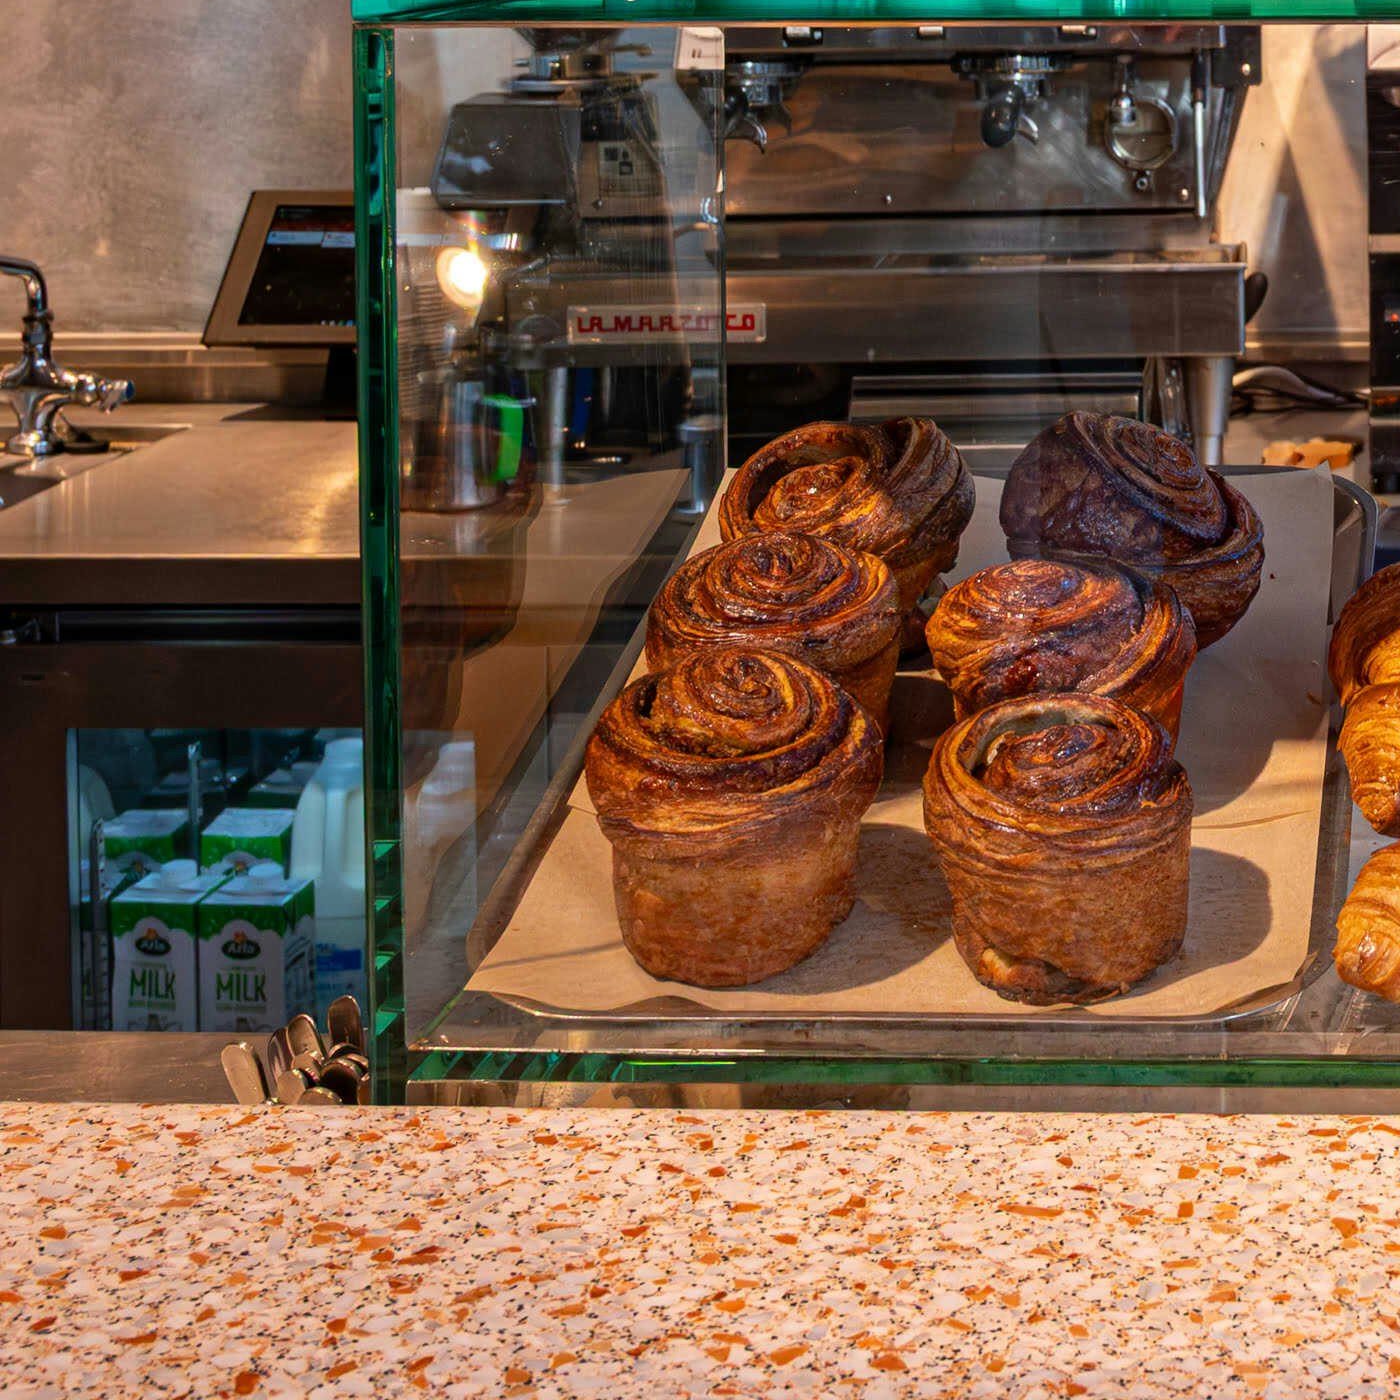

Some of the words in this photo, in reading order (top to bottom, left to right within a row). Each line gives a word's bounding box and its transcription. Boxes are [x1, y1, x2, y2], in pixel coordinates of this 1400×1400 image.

[577, 315, 602, 333] LA
[130, 968, 176, 999] MILK
[216, 972, 267, 1001] MILK
